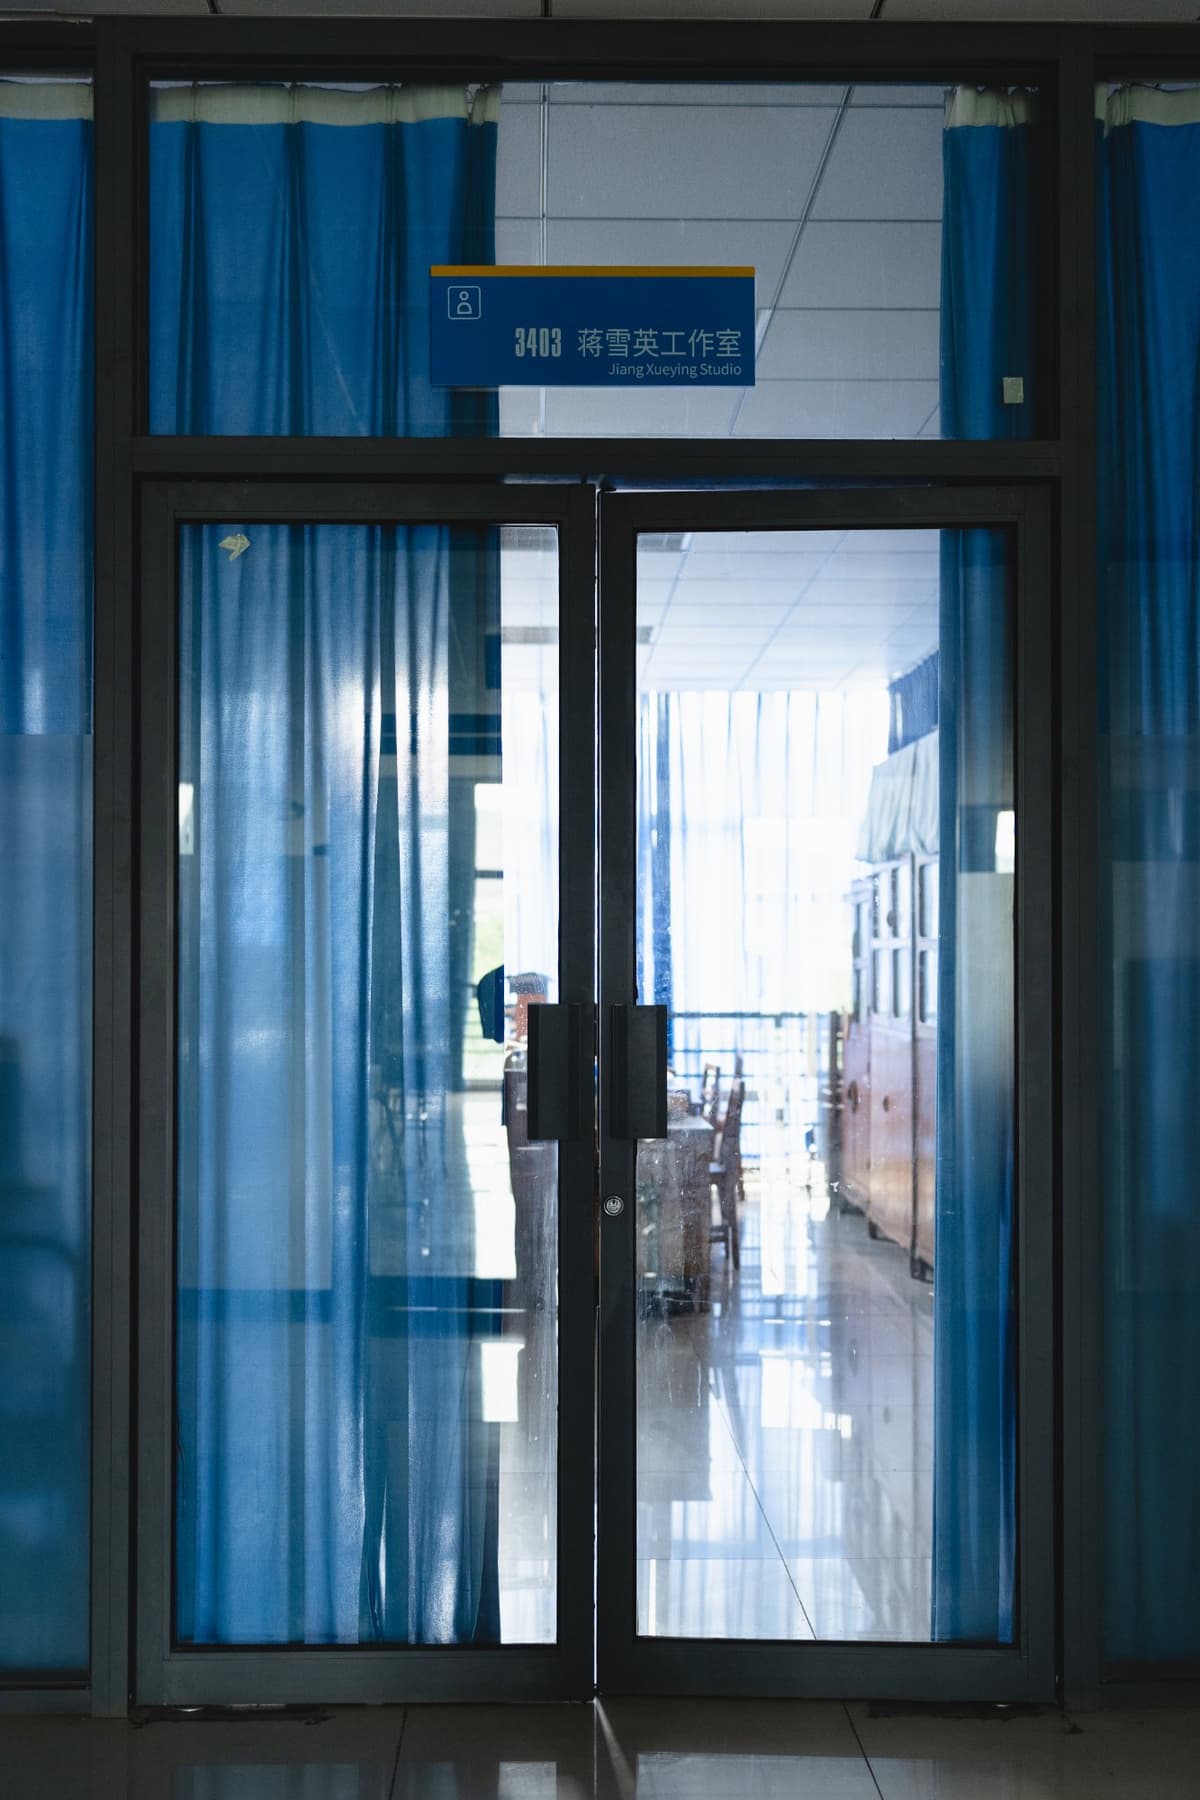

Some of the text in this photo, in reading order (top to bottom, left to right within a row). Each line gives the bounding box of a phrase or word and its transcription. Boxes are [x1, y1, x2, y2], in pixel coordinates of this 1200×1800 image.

[514, 327, 742, 358] 3403 蒋雪英工作室
[608, 362, 742, 378] Jiang Xueying Studio
